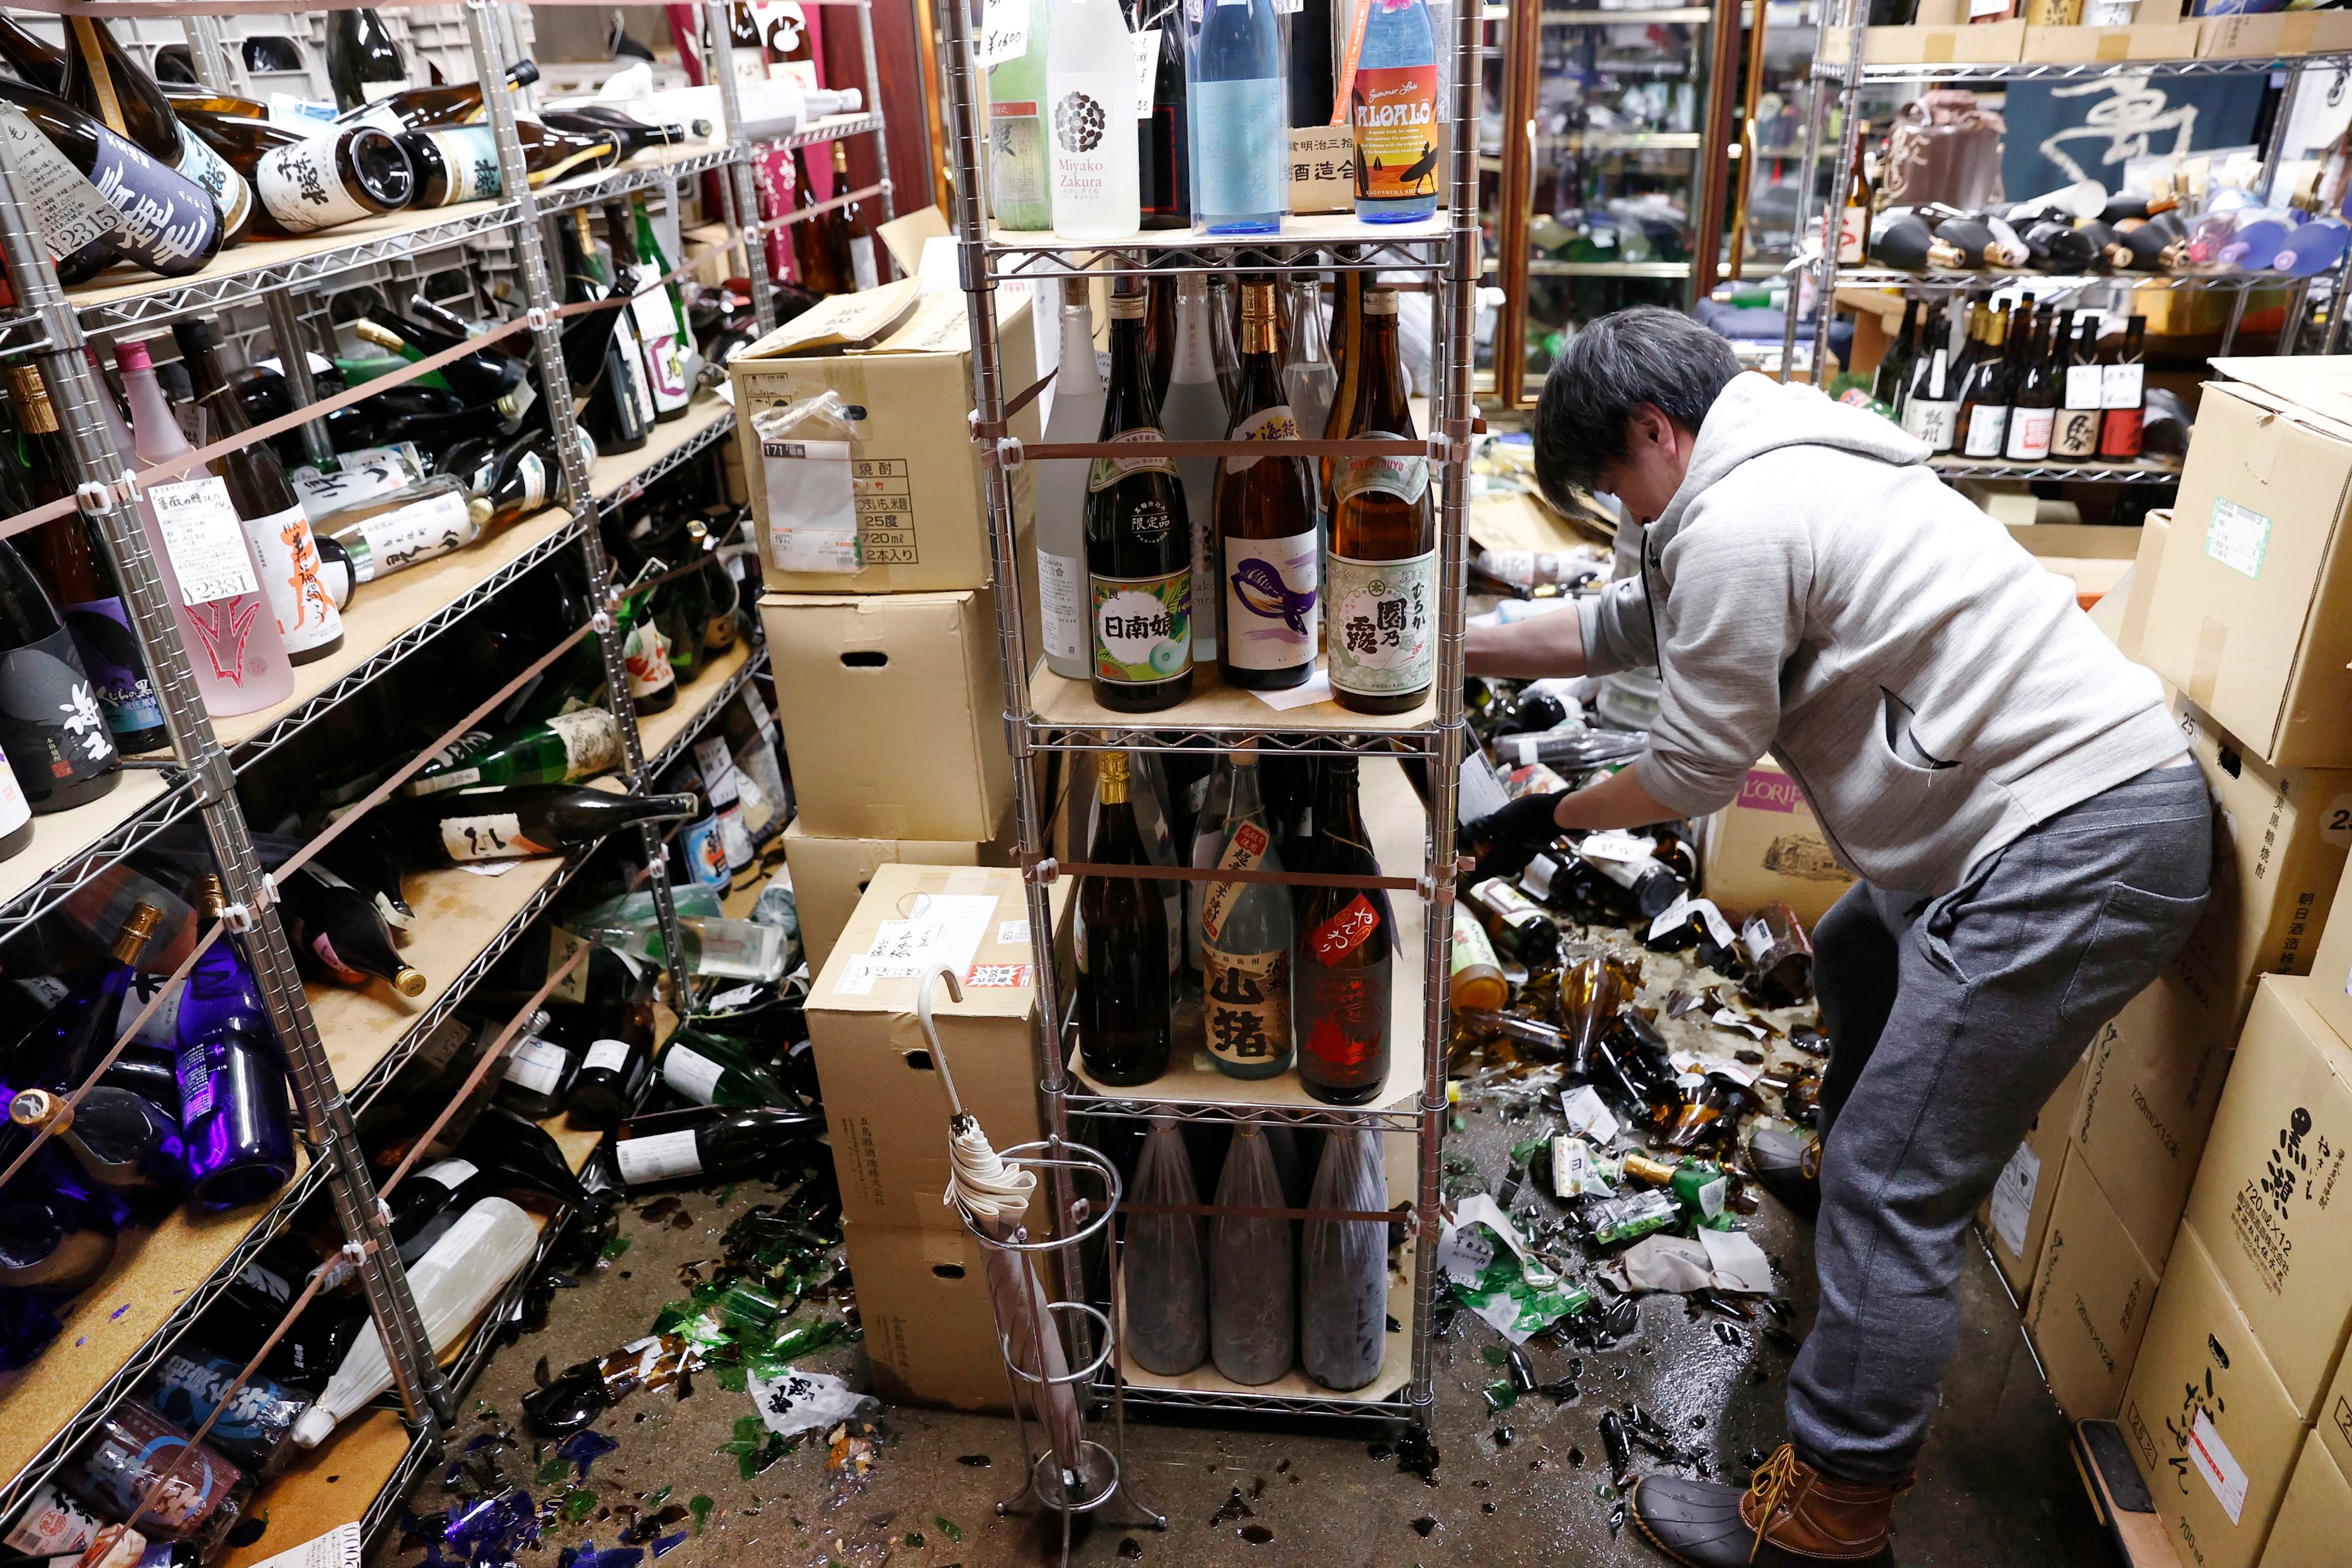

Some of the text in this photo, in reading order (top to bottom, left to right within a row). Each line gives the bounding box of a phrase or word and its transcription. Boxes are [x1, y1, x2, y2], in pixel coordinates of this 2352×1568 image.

[1368, 88, 1399, 103] Summer
[1059, 159, 1103, 174] Miyako
[1060, 175, 1102, 188] Zakura
[45, 207, 118, 258] ¥2315
[765, 444, 783, 456] 171
[859, 461, 892, 476] 焼酎
[865, 516, 899, 528] 25度
[1131, 515, 1170, 532] 限定品
[1105, 612, 1175, 639] 日南娘
[2255, 778, 2290, 880] 奄美黒糖焼酎
